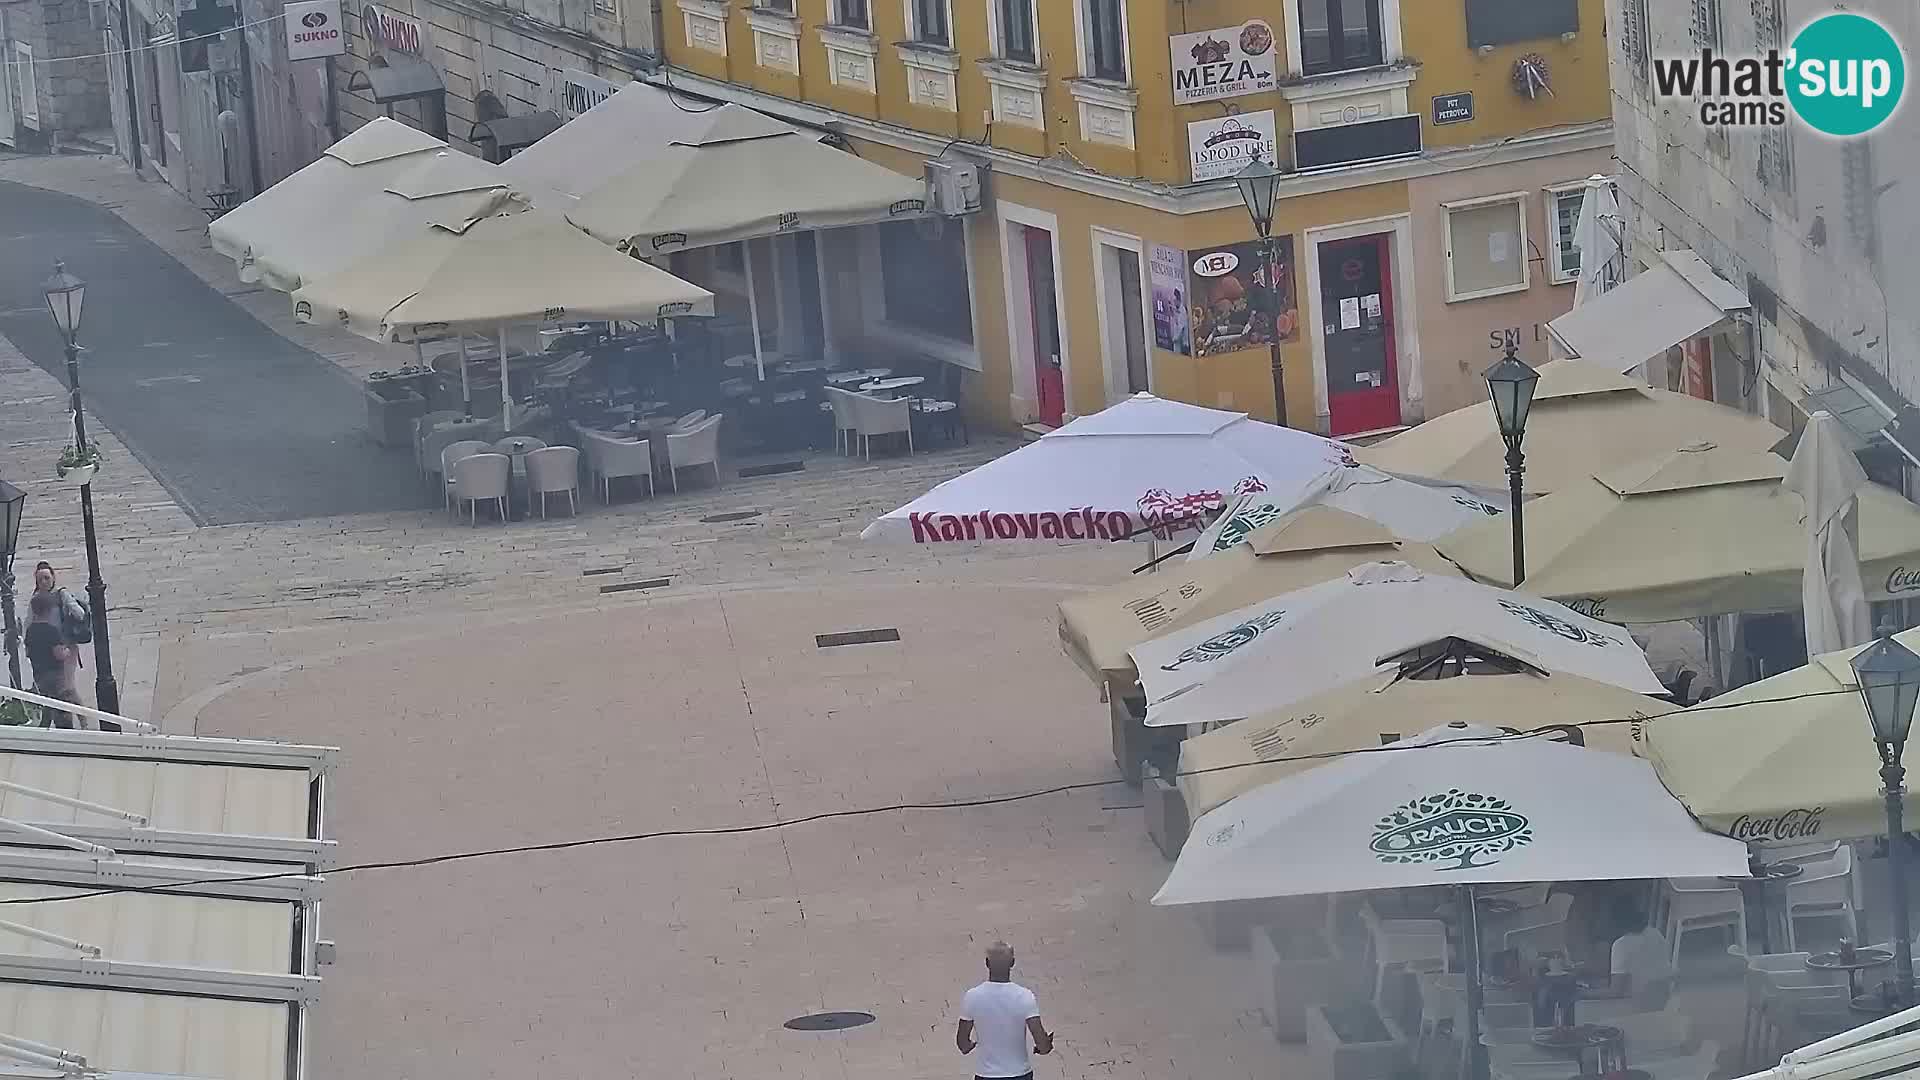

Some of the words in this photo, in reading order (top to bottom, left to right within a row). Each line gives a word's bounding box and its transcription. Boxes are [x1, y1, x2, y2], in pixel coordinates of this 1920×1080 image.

[294, 29, 338, 43] SUKNO
[380, 14, 420, 53] SUKNO
[1176, 59, 1255, 90] MEZA
[1185, 87, 1218, 98] PIZZERIA
[1226, 81, 1247, 93] GRILL
[1195, 145, 1241, 163] ISPOD
[909, 505, 1133, 543] Karlovačko
[1410, 816, 1509, 845] RAUCH
